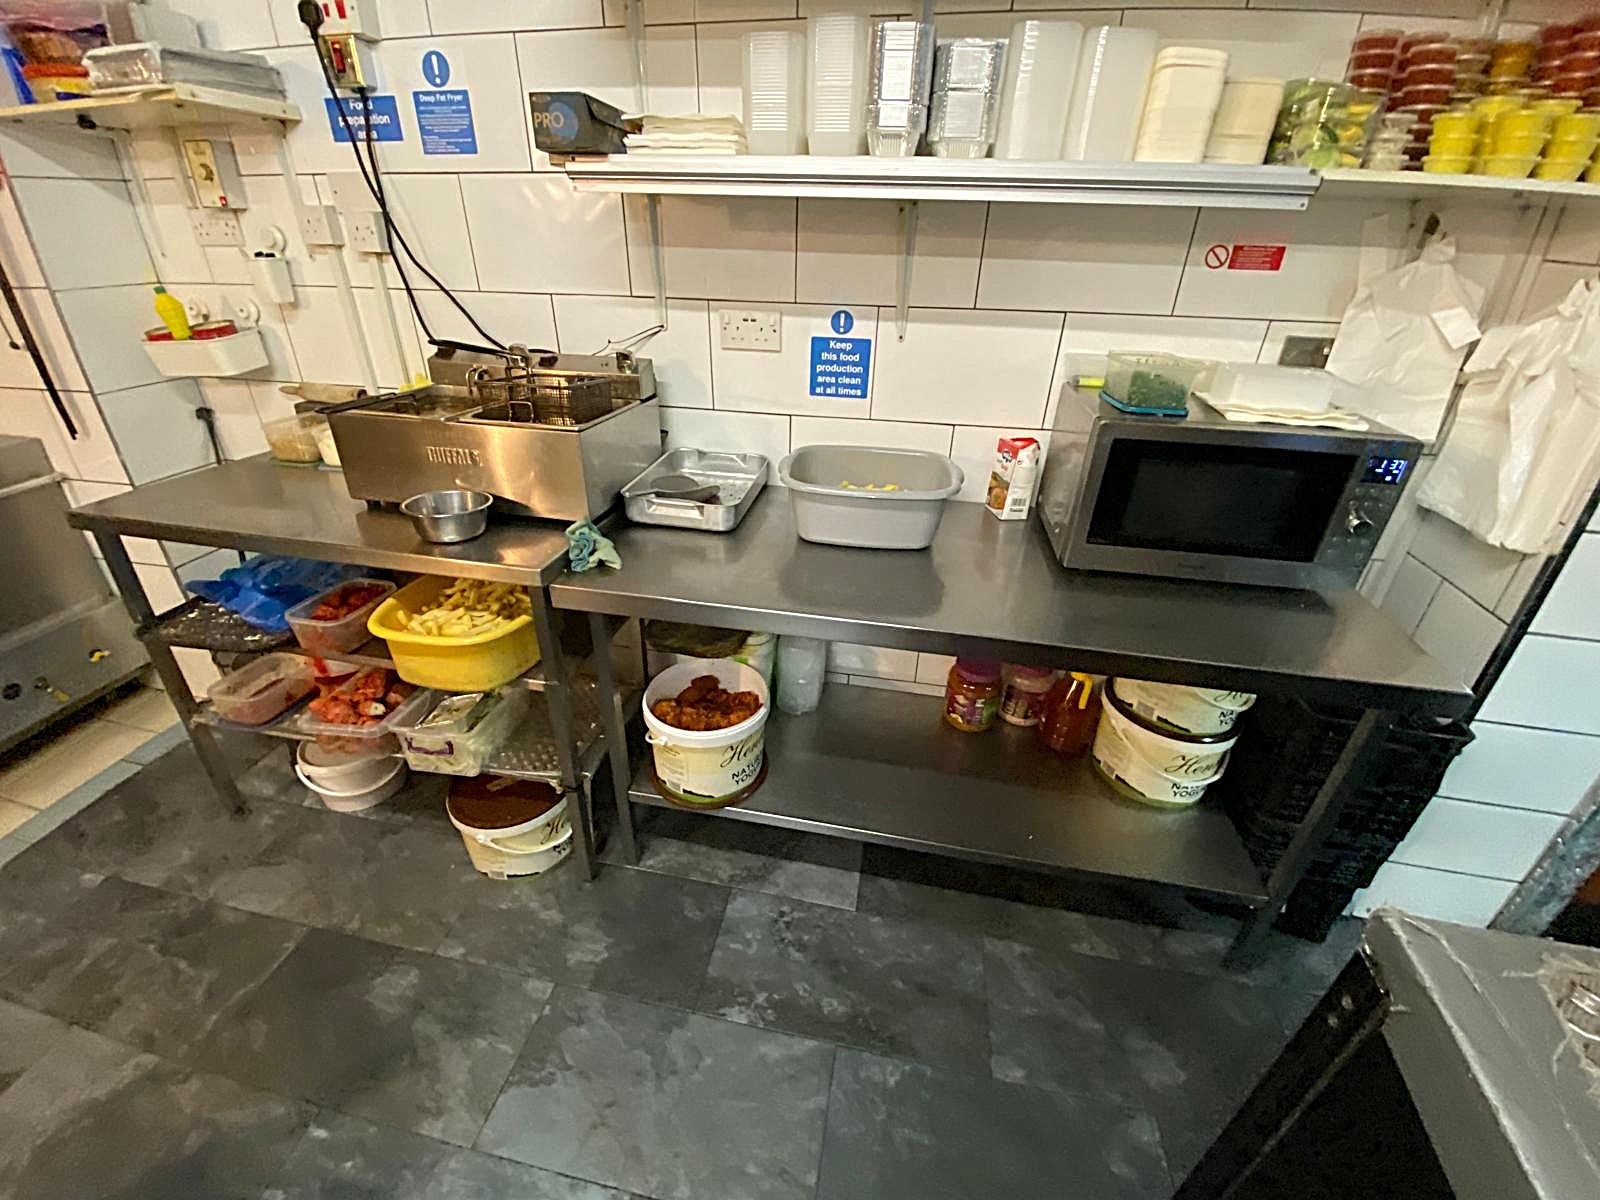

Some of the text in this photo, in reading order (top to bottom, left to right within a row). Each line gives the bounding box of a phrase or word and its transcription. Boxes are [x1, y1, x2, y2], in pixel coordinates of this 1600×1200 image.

[419, 94, 435, 103] Deep
[447, 93, 463, 103] Fryer
[349, 99, 374, 110] Fod
[533, 111, 564, 128] PRO
[829, 340, 853, 351] Keep
[821, 351, 860, 362] this food
[816, 363, 864, 374] production
[817, 375, 861, 385] area clean
[815, 386, 862, 396] at all times
